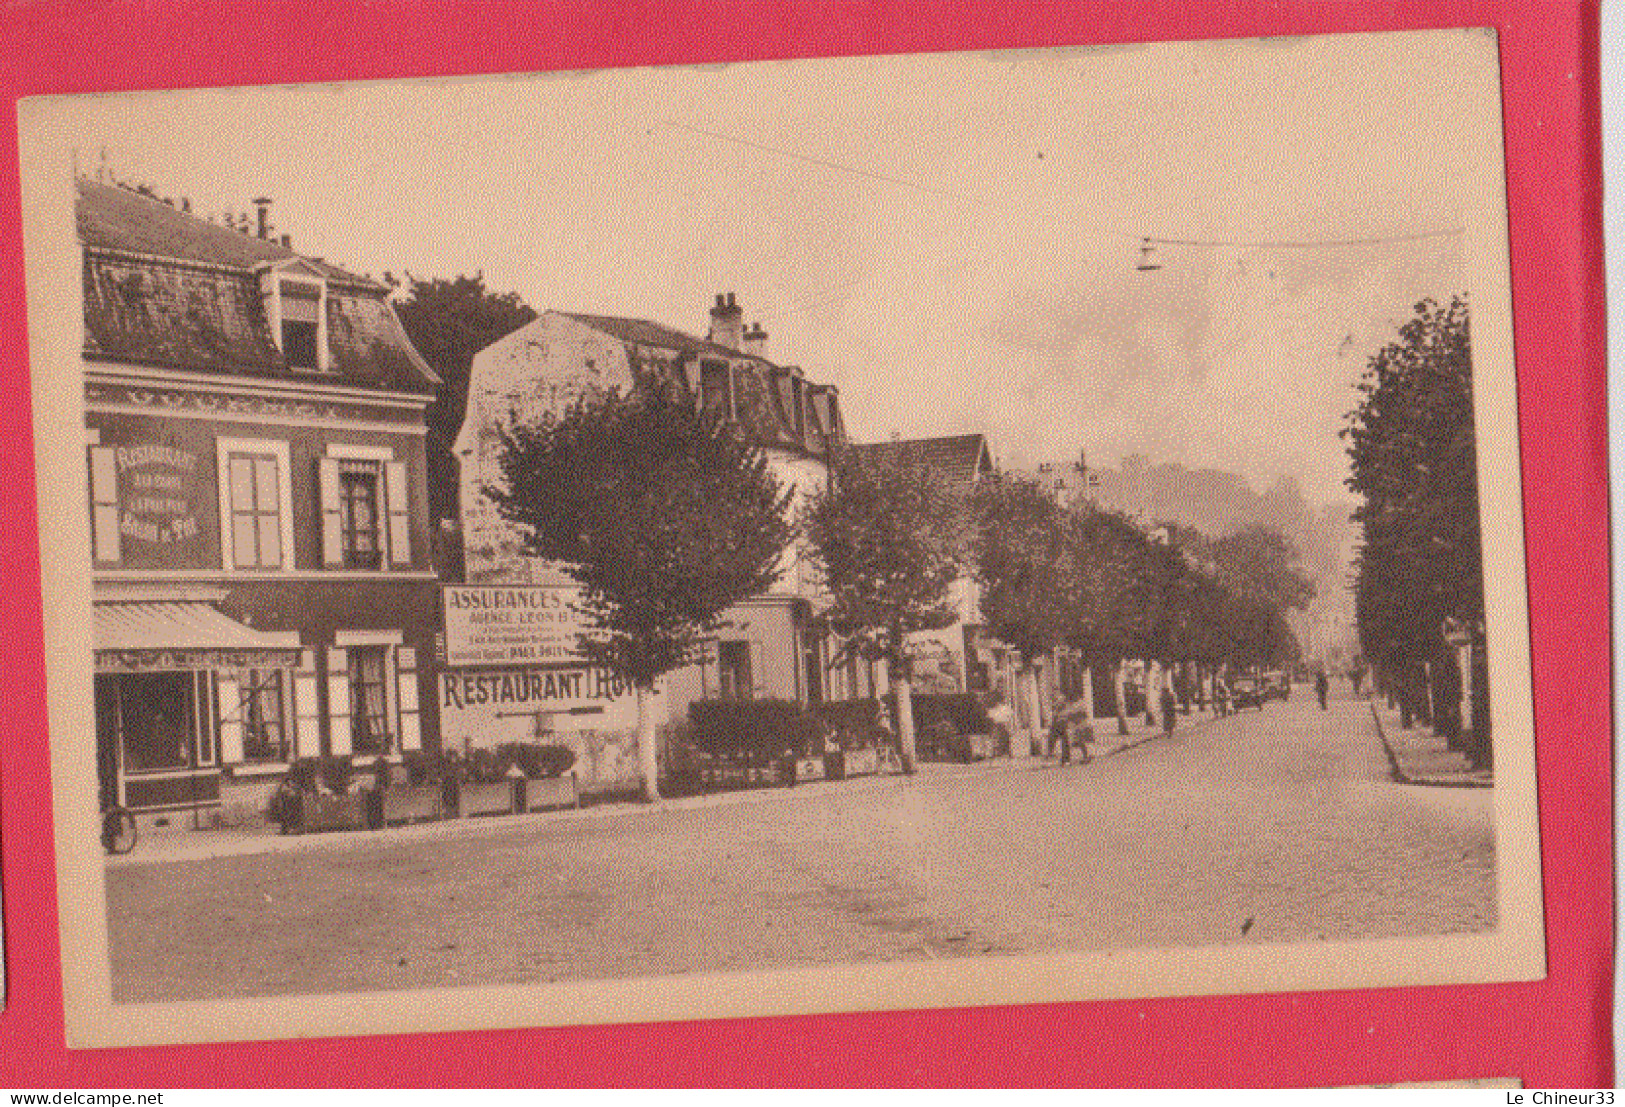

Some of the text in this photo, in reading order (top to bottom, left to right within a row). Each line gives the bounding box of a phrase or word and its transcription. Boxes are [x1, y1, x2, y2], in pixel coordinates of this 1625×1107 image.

[449, 590, 561, 609] ASSURANCES
[469, 612, 513, 624] AGENCE
[443, 672, 583, 709] RESTAURANT
